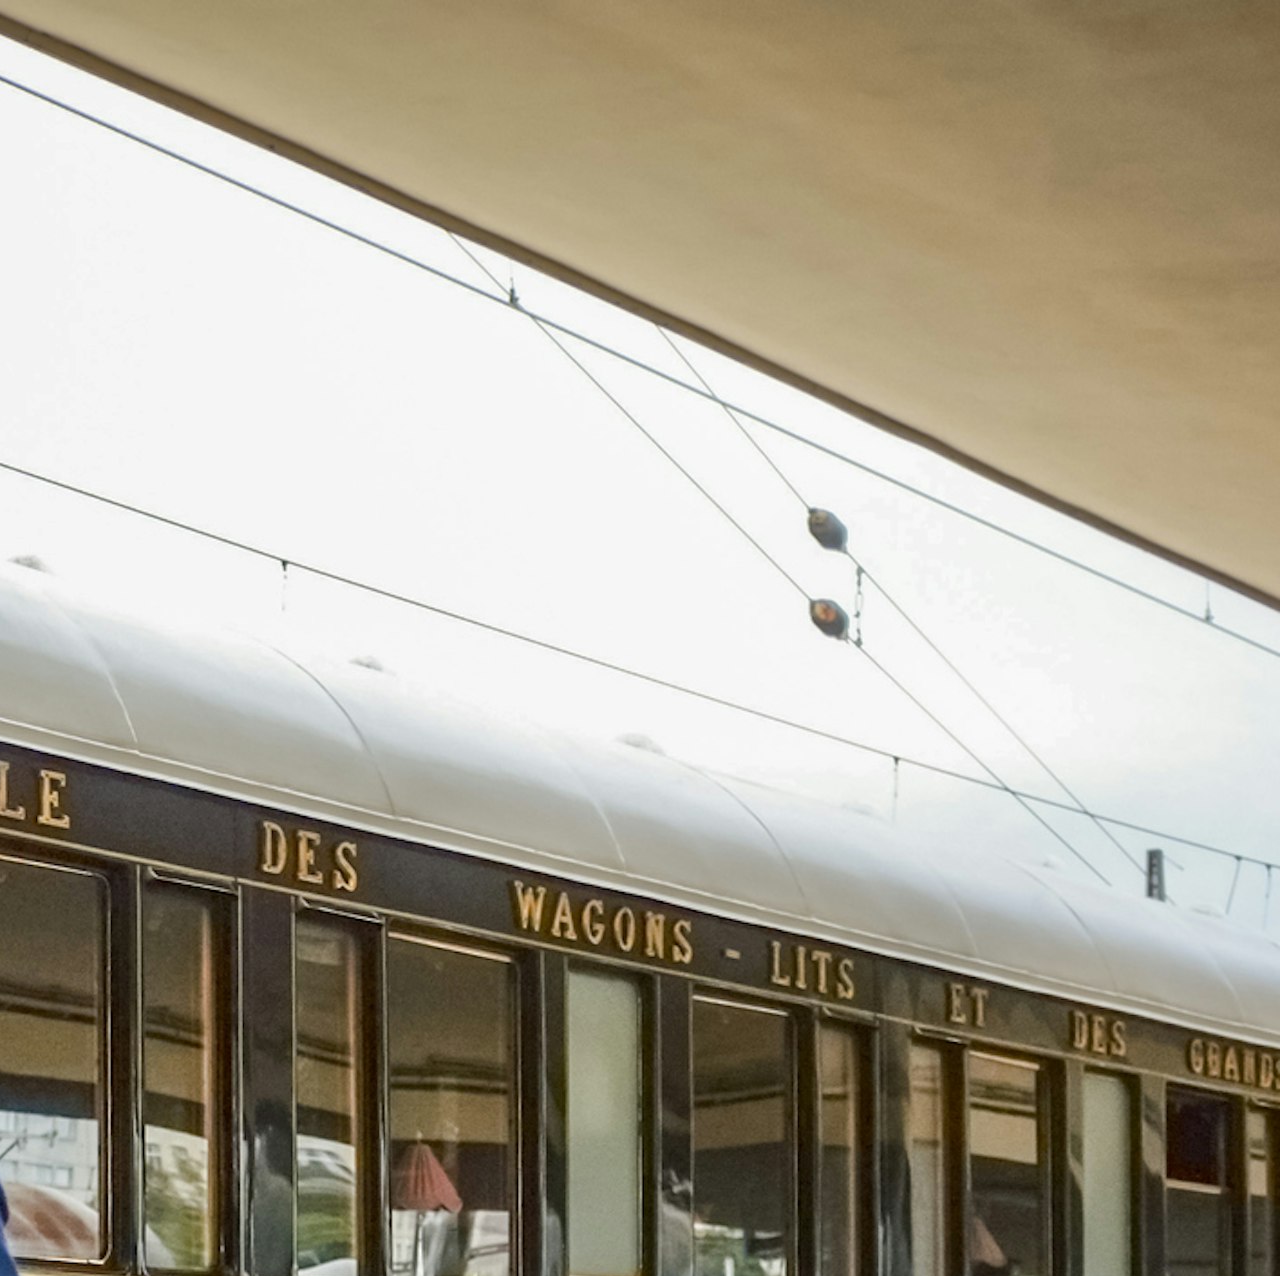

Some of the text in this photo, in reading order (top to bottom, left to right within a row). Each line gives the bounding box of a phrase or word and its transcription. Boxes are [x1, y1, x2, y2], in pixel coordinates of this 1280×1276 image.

[260, 820, 358, 893] DES
[513, 879, 694, 964] WAGONS
[770, 939, 855, 1001] LITS
[949, 982, 989, 1028] ET
[1071, 1008, 1127, 1058] DES
